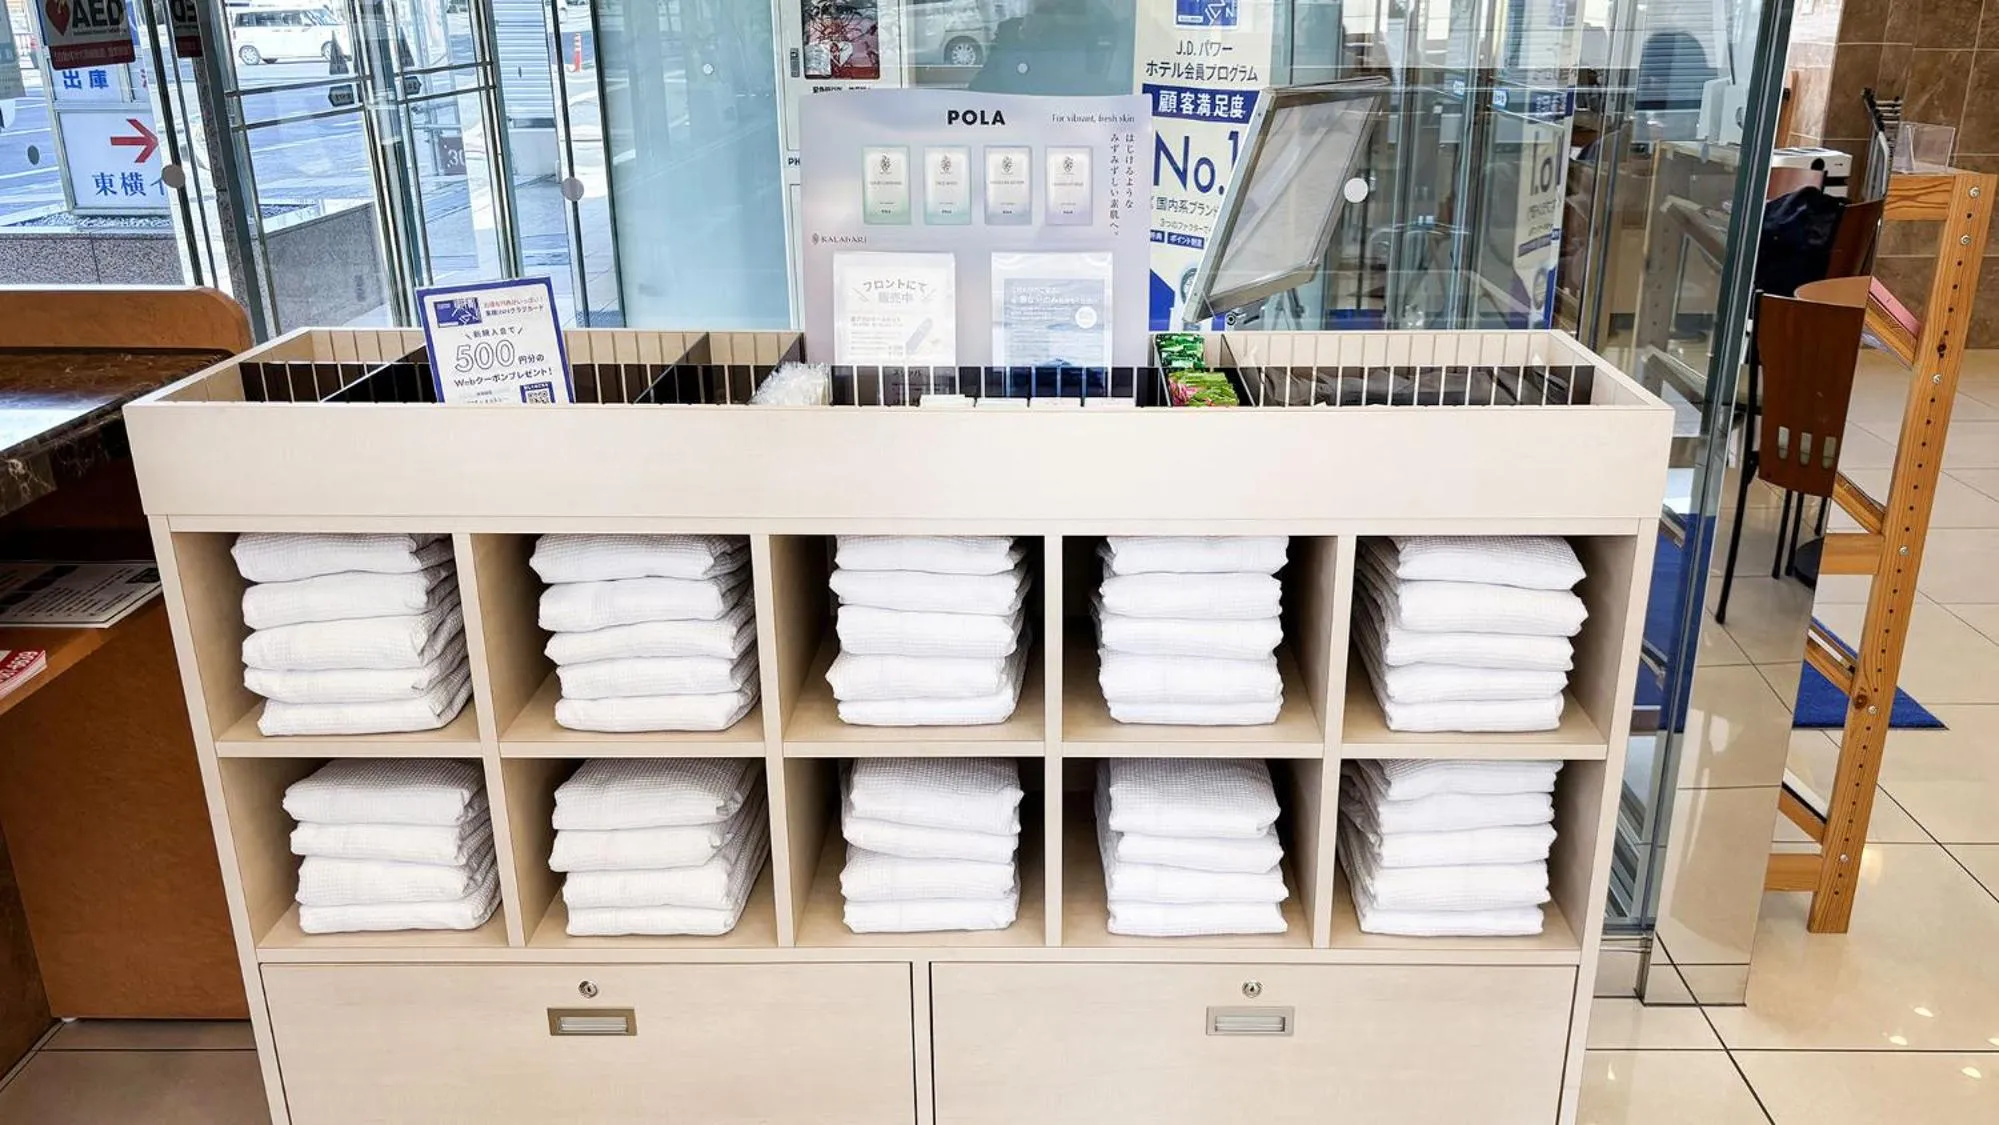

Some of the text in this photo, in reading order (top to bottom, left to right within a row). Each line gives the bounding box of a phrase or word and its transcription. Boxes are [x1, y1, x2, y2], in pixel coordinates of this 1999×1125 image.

[72, 0, 124, 27] AED
[63, 70, 109, 90] 出庫
[1146, 60, 1258, 82] ホテル会員プログラム
[1158, 90, 1247, 119] 顧客満足度
[947, 110, 1006, 126] POLA
[1052, 113, 1135, 124] For vibrant, fresh skin
[1126, 133, 1135, 209] はじけるような
[1153, 130, 1239, 193] No.1
[863, 278, 928, 293] フロントにて
